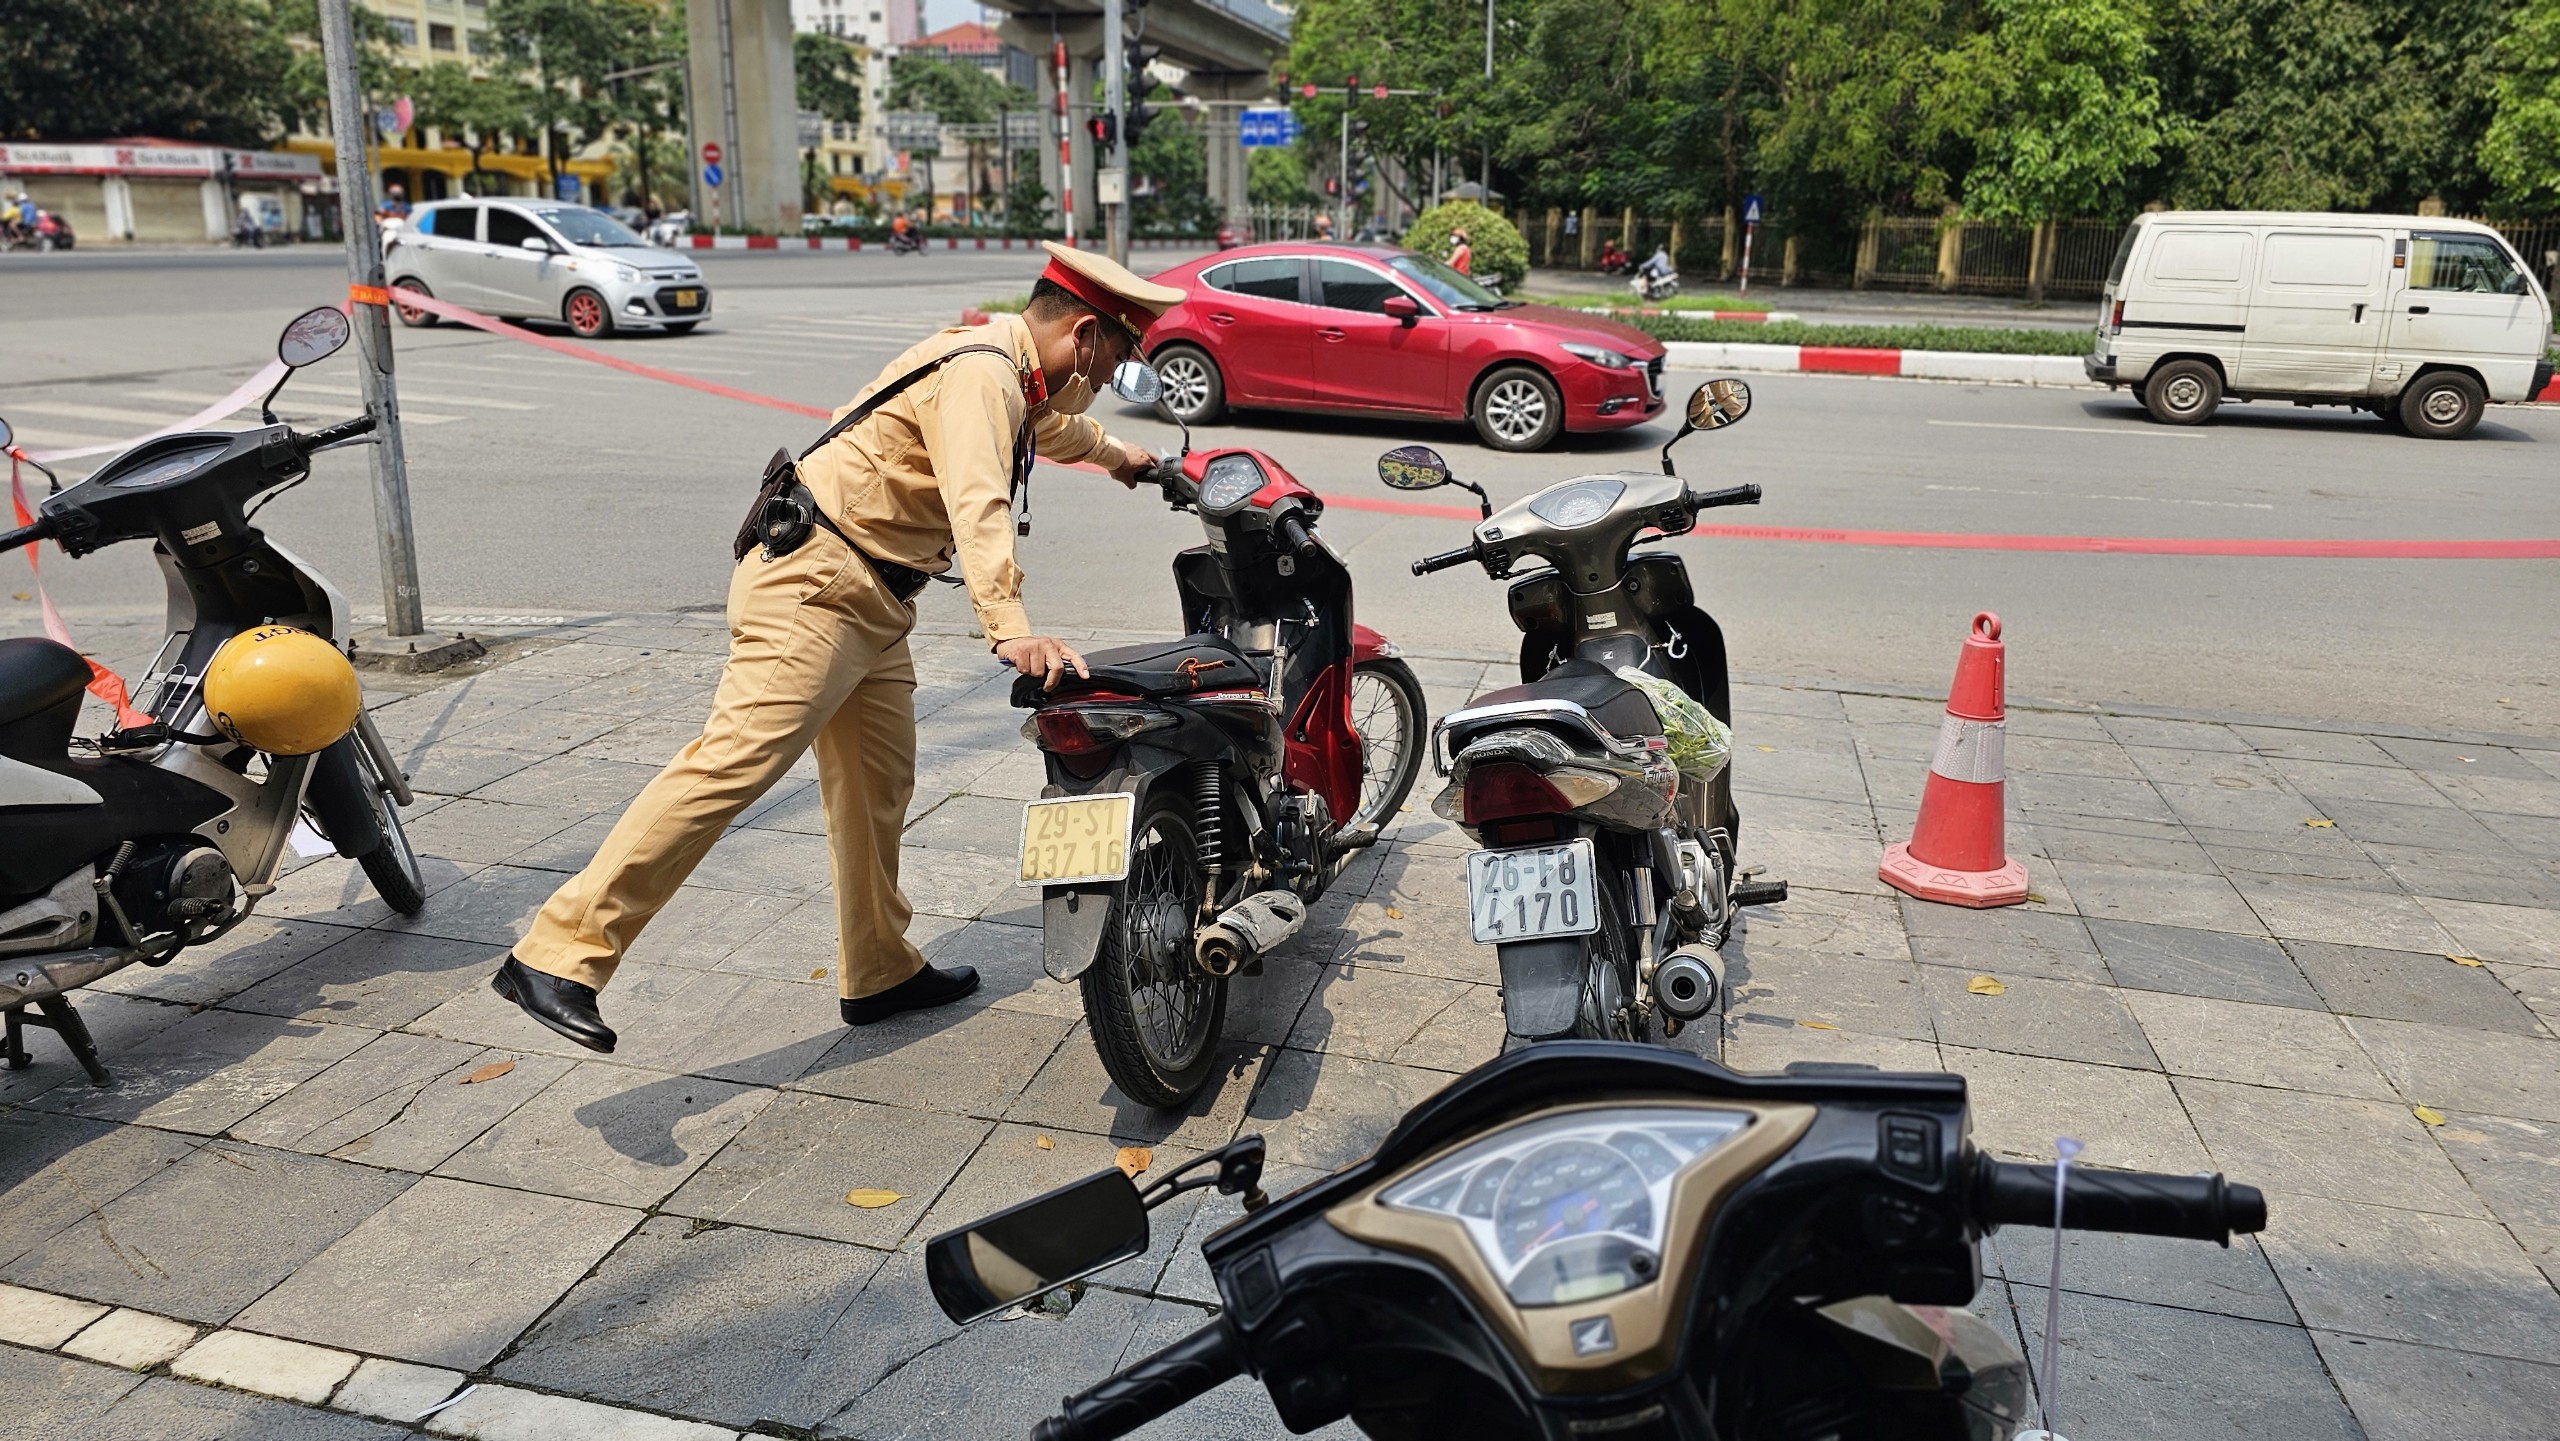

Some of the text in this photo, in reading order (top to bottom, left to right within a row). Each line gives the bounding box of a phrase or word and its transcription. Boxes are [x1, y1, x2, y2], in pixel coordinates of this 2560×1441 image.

[1472, 748, 1510, 760] HONDA
[1038, 802, 1114, 840] 29-S1
[1026, 839, 1122, 879] 337.16
[1483, 847, 1576, 892] 26-F8
[1487, 888, 1579, 935] 4170
